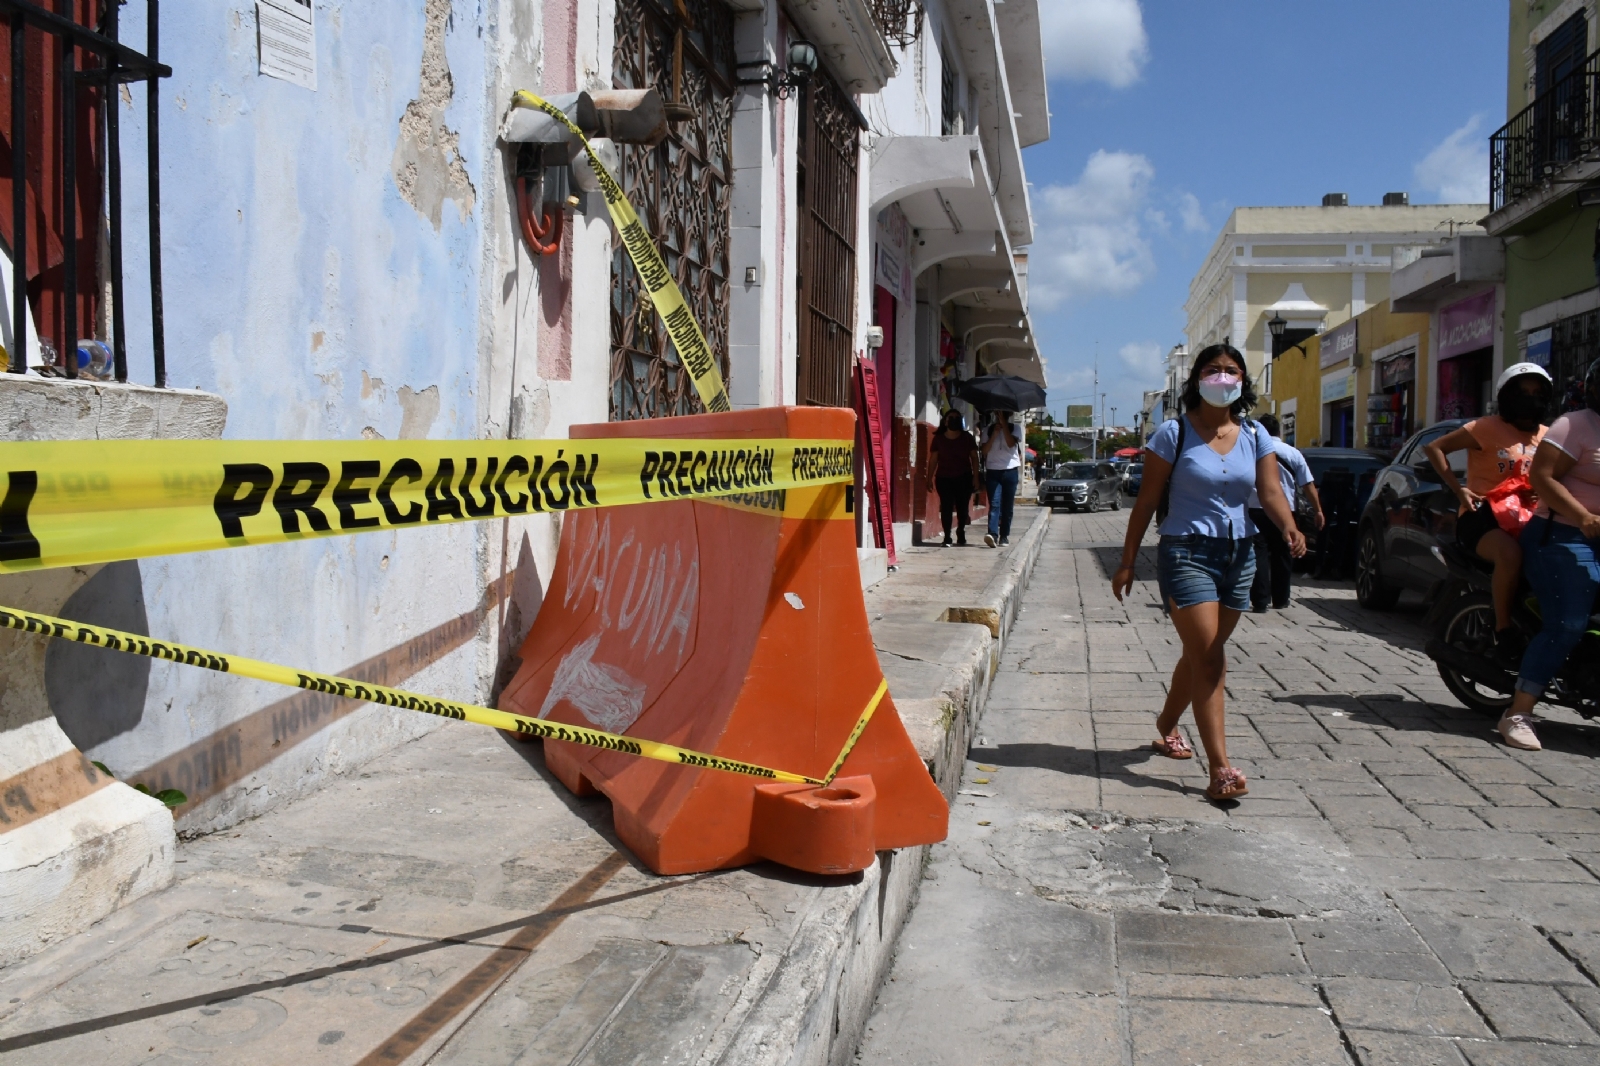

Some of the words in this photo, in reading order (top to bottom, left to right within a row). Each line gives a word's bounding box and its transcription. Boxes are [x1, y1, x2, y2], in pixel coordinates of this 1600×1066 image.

[1448, 314, 1493, 346] MICHOACANA
[213, 450, 600, 538] PRECAUCIÓN
[640, 446, 774, 498] PRECAUCIÓN
[563, 512, 700, 672] VACUNA
